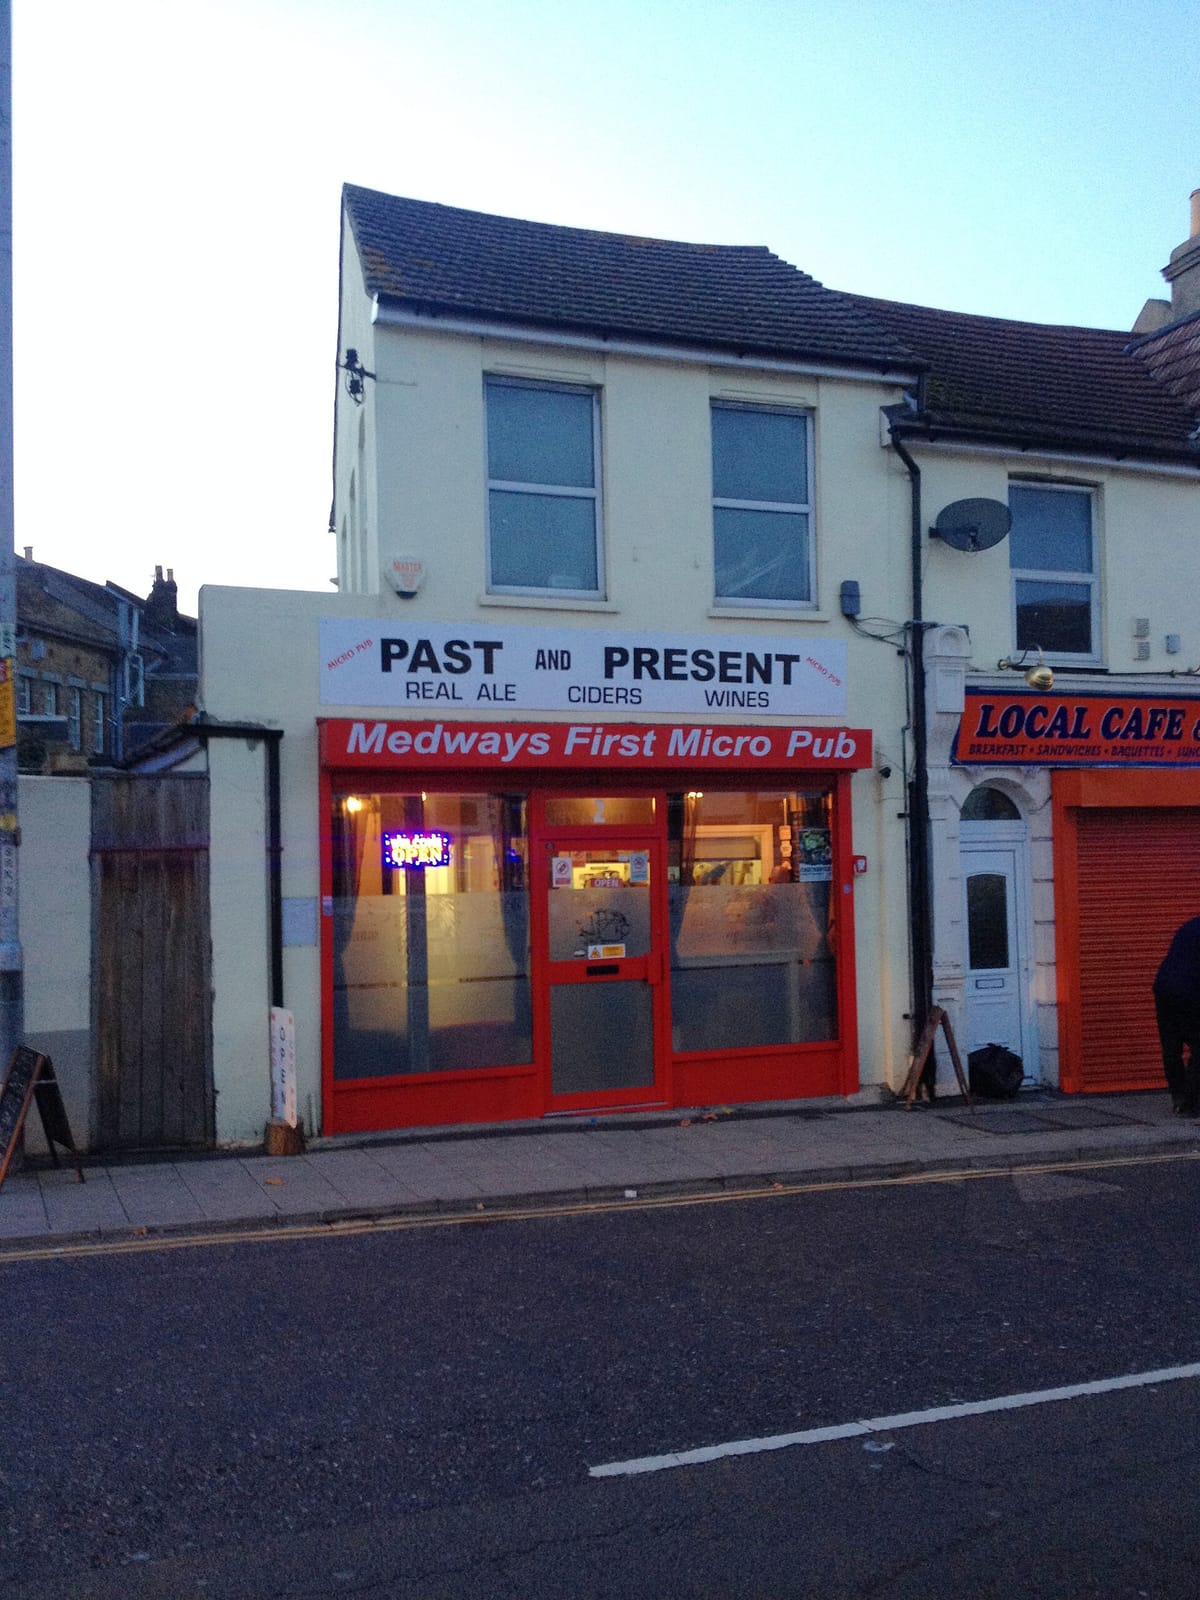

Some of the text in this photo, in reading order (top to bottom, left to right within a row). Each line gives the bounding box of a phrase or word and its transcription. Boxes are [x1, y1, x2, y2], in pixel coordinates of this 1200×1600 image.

[327, 639, 373, 671] MICRO PUB
[380, 638, 800, 685] PAST AND PRESENT
[405, 681, 769, 708] REAL ALE CIDERS WINES
[975, 704, 1091, 739] LOCAL
[1100, 706, 1186, 741] CAFE
[346, 722, 857, 763] Medways First Micro Pub
[593, 799, 606, 823] 2
[594, 878, 619, 888] OPEN
